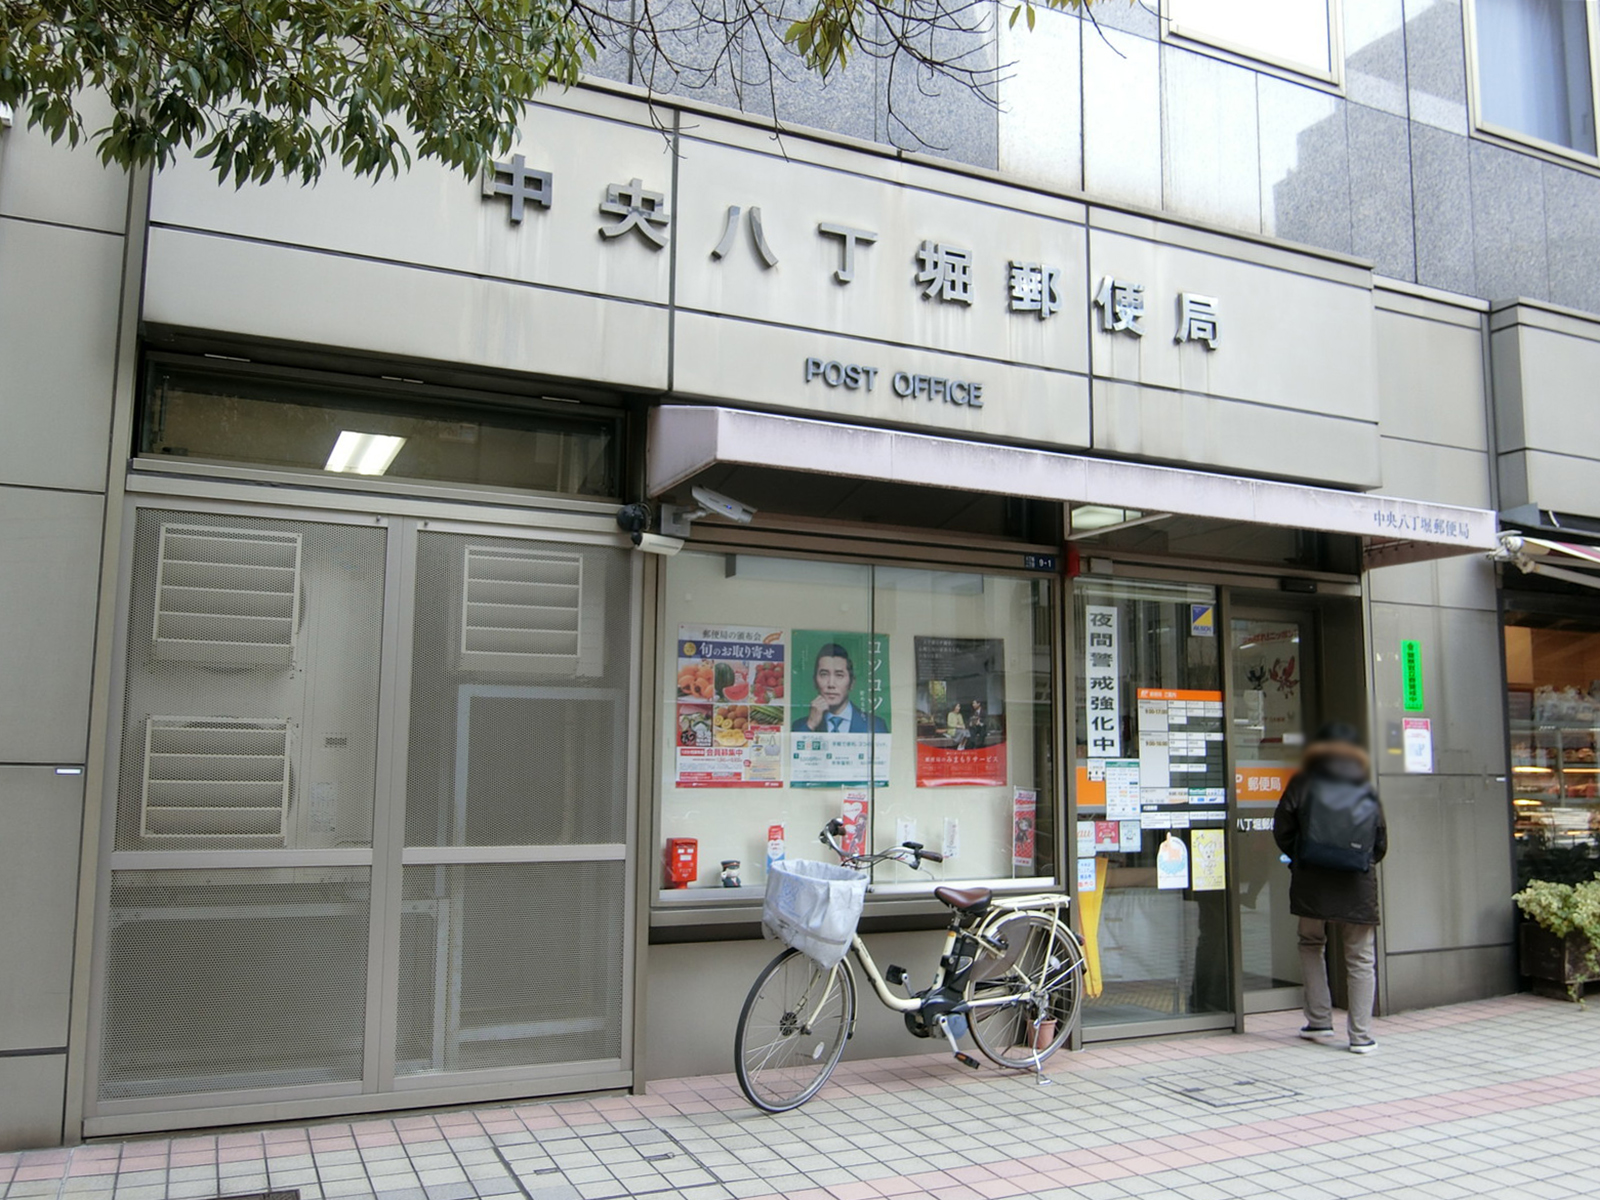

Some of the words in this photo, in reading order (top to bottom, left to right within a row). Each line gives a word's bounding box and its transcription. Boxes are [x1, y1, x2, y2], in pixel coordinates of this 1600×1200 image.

[481, 154, 1221, 350] 中央八丁堀郵便局
[805, 357, 878, 392] POST
[891, 371, 984, 409] OFFICE
[1373, 509, 1470, 539] 中央八丁堀郵便局
[699, 642, 775, 659] 旬のお取り寄せ
[867, 641, 884, 713] コツコツ
[1090, 612, 1115, 752] 夜間警戒強化中
[1248, 777, 1281, 791] 郵便局
